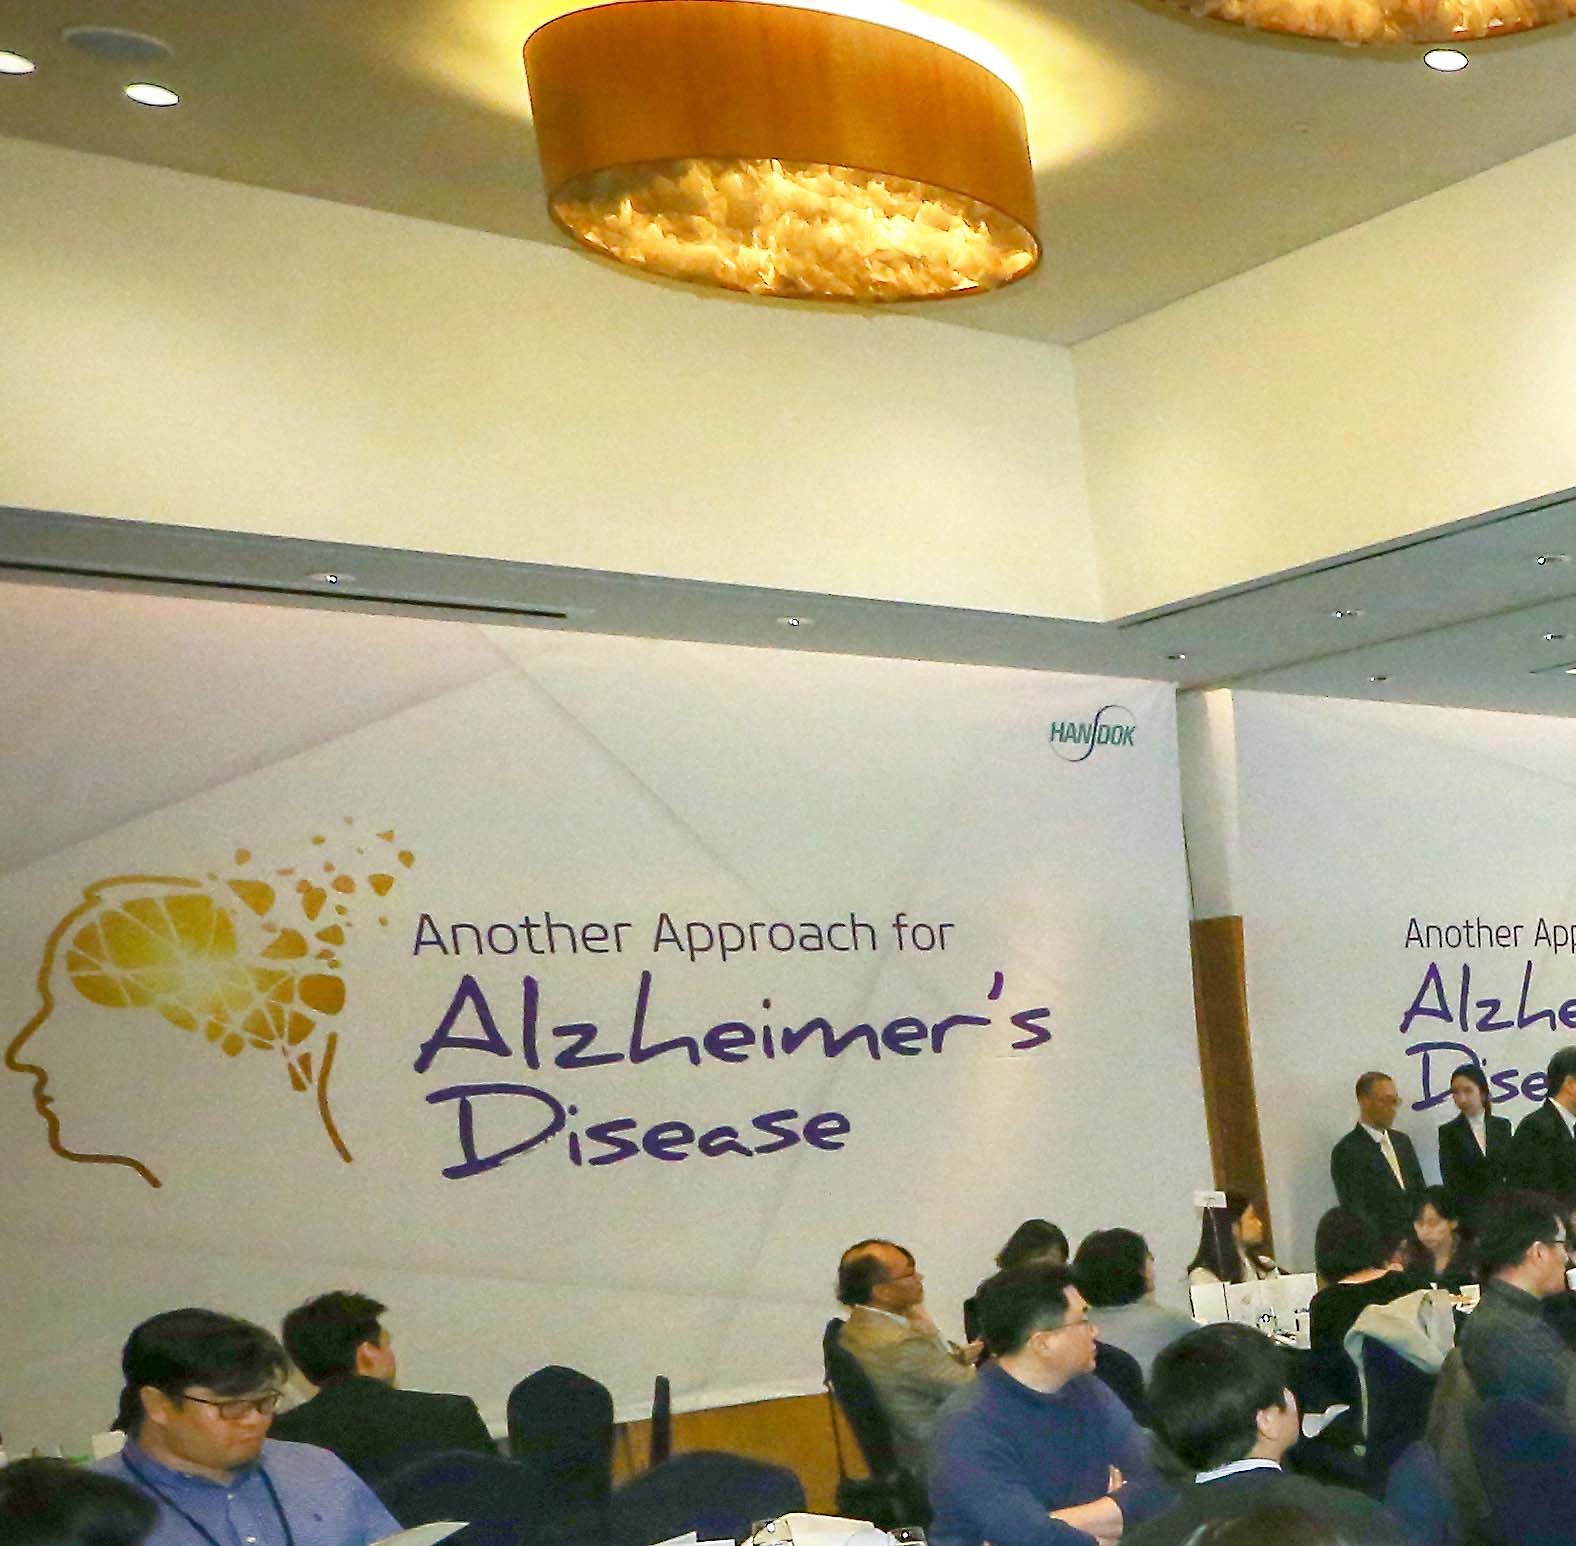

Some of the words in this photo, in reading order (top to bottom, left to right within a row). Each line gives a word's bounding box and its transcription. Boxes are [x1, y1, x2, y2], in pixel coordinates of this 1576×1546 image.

[412, 911, 632, 957] Another
[652, 911, 877, 963] Approach
[890, 912, 955, 953] for
[1404, 916, 1524, 950] Another
[414, 970, 1054, 1072] Alzheimer's
[426, 1081, 852, 1179] Disease
